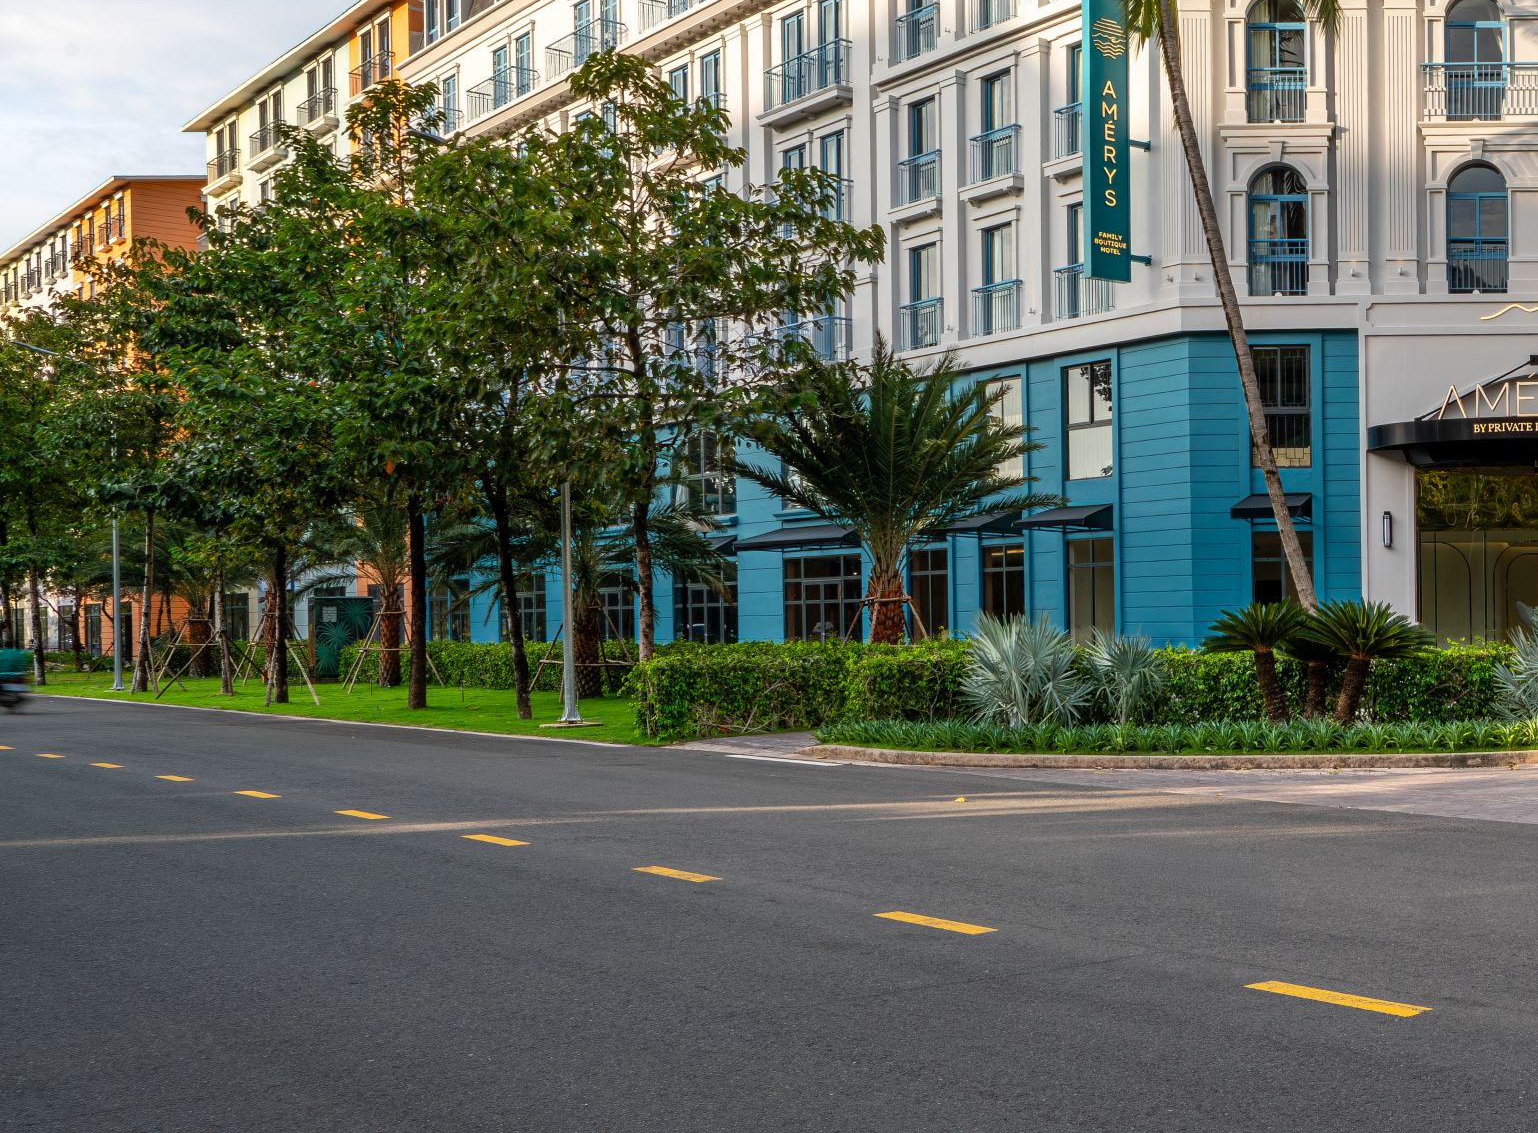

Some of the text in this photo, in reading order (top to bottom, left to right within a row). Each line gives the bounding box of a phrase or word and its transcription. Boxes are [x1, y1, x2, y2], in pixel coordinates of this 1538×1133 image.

[1101, 80, 1118, 207] AMÉRYS
[1098, 231, 1123, 241] FAMILY
[1094, 237, 1127, 249] BOUTIQUE
[1100, 246, 1121, 256] HOTEL
[1473, 423, 1487, 433] BY
[1488, 422, 1533, 433] PRIVATE
